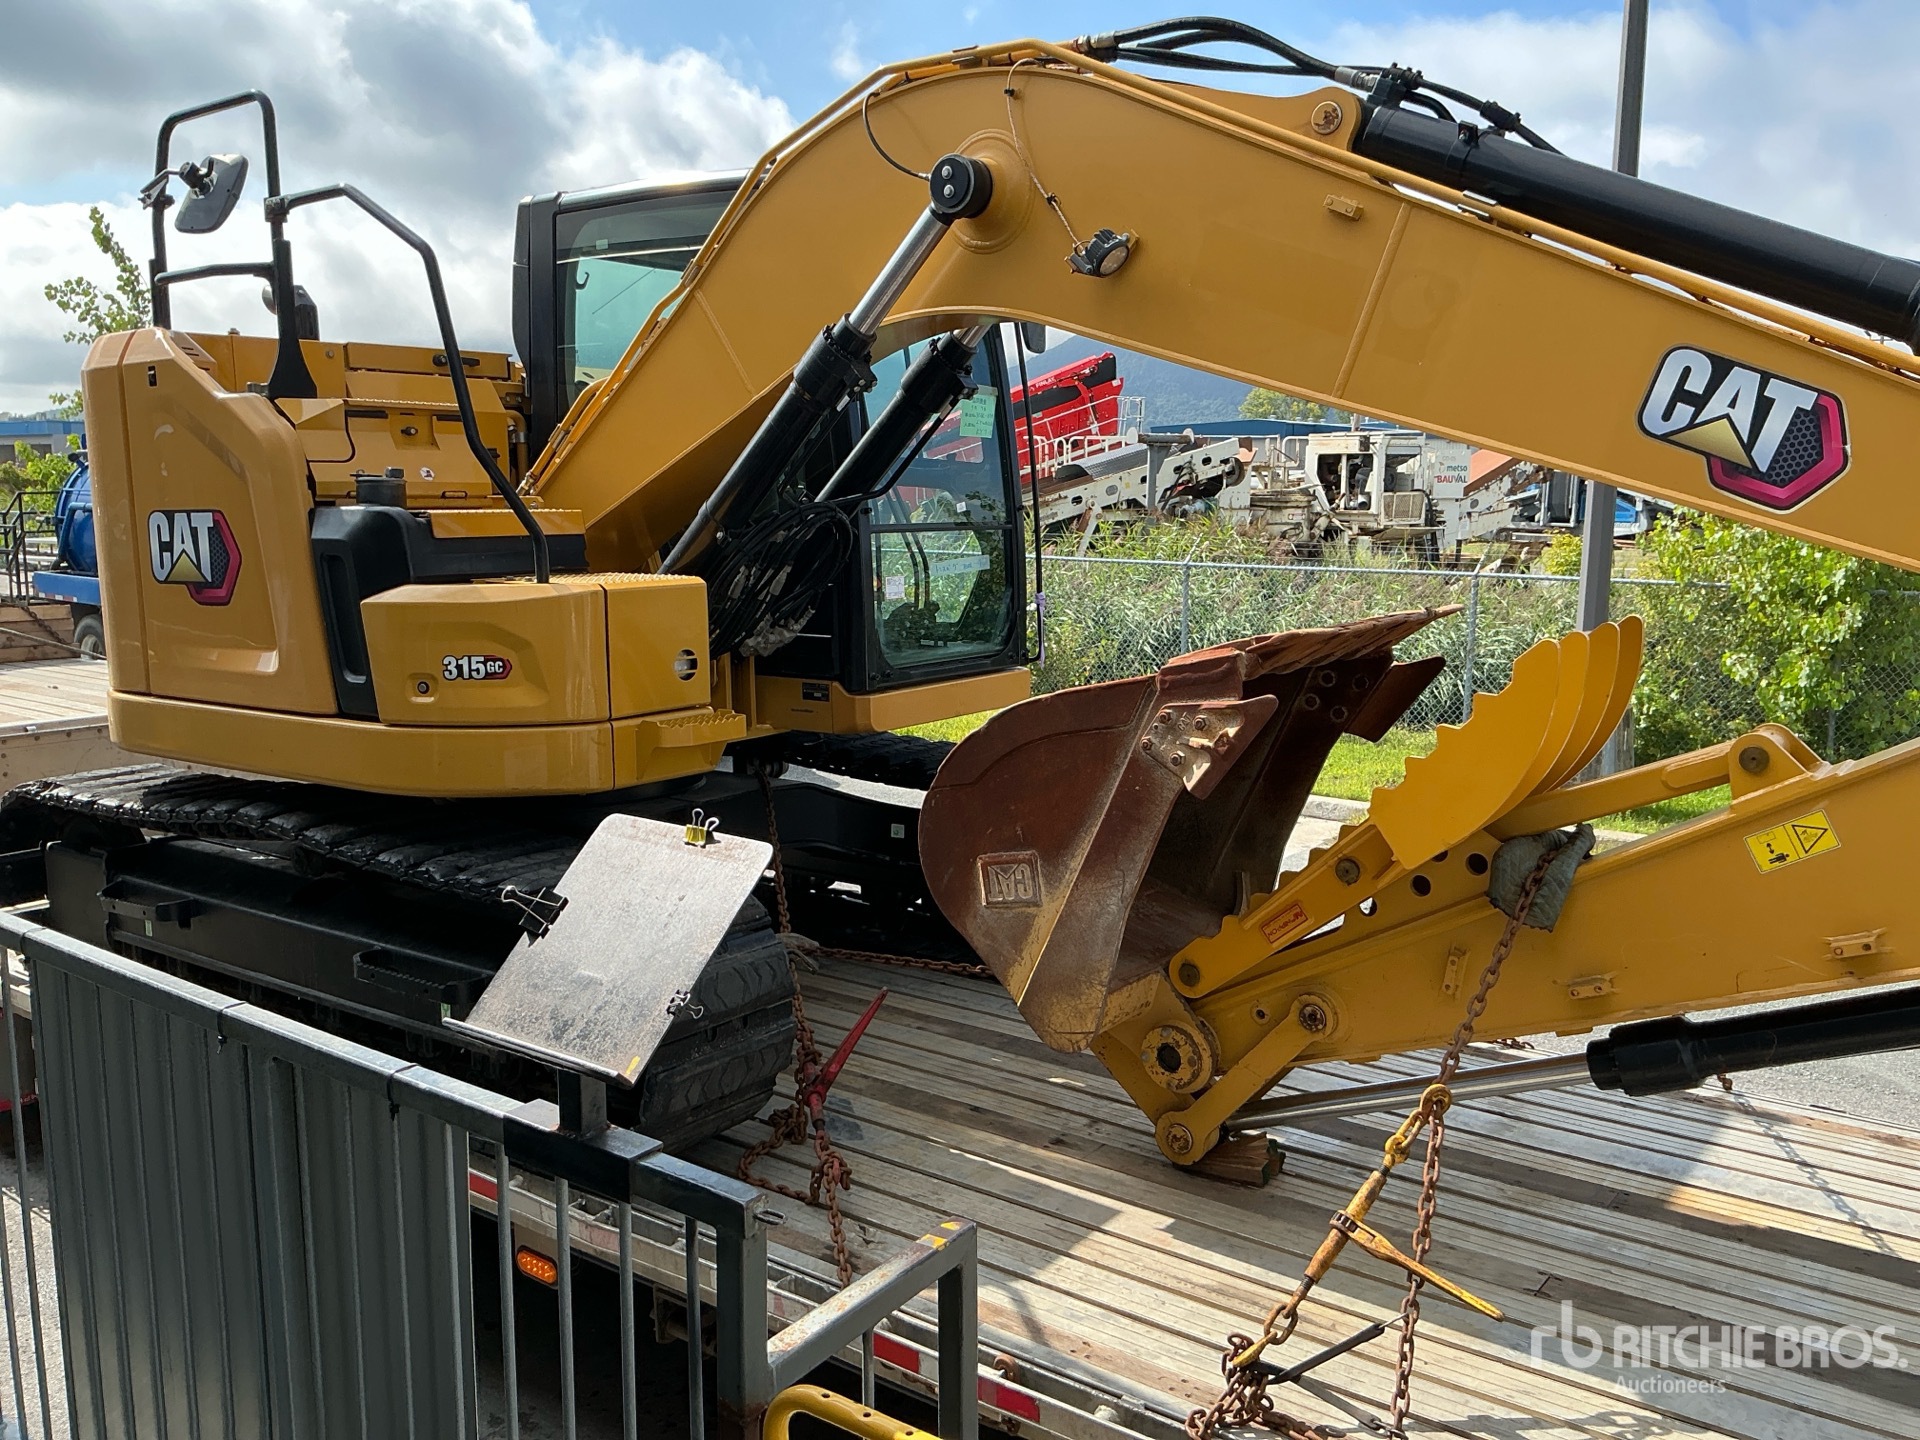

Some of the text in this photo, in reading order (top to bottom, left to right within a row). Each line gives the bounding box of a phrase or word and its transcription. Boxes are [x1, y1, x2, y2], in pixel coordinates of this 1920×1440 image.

[1642, 349, 1819, 474] CAT
[1435, 474, 1468, 483] BAUVAL
[1446, 464, 1468, 472] metso
[149, 511, 213, 582] CAT
[443, 656, 504, 680] 315 GC
[987, 863, 1034, 900] CAT
